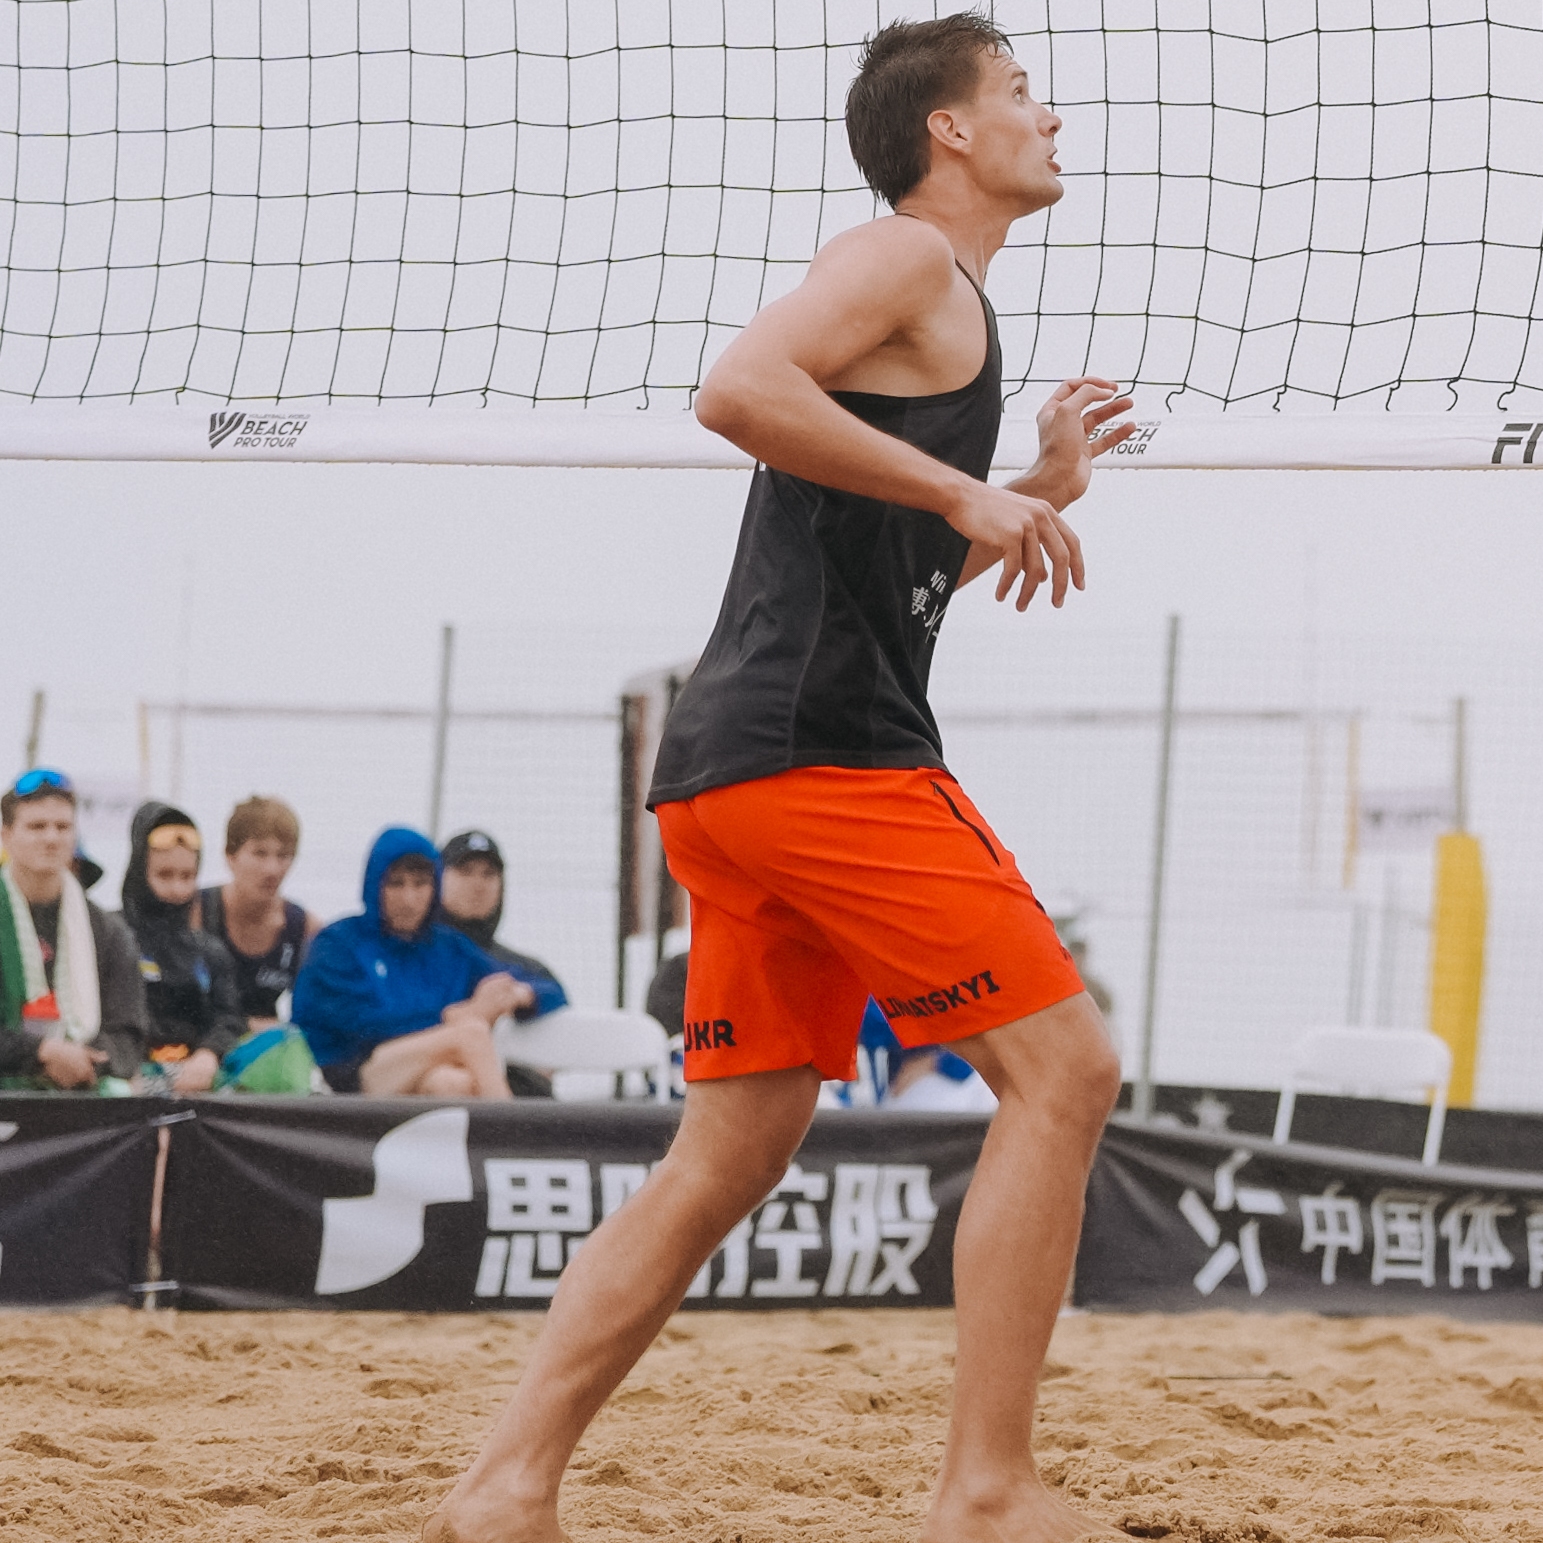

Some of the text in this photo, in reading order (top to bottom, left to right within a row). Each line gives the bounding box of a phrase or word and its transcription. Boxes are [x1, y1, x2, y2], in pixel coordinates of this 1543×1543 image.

[240, 420, 308, 435] BEACH
[233, 437, 297, 447] PRO TOUR
[475, 1159, 939, 1298] 思控股
